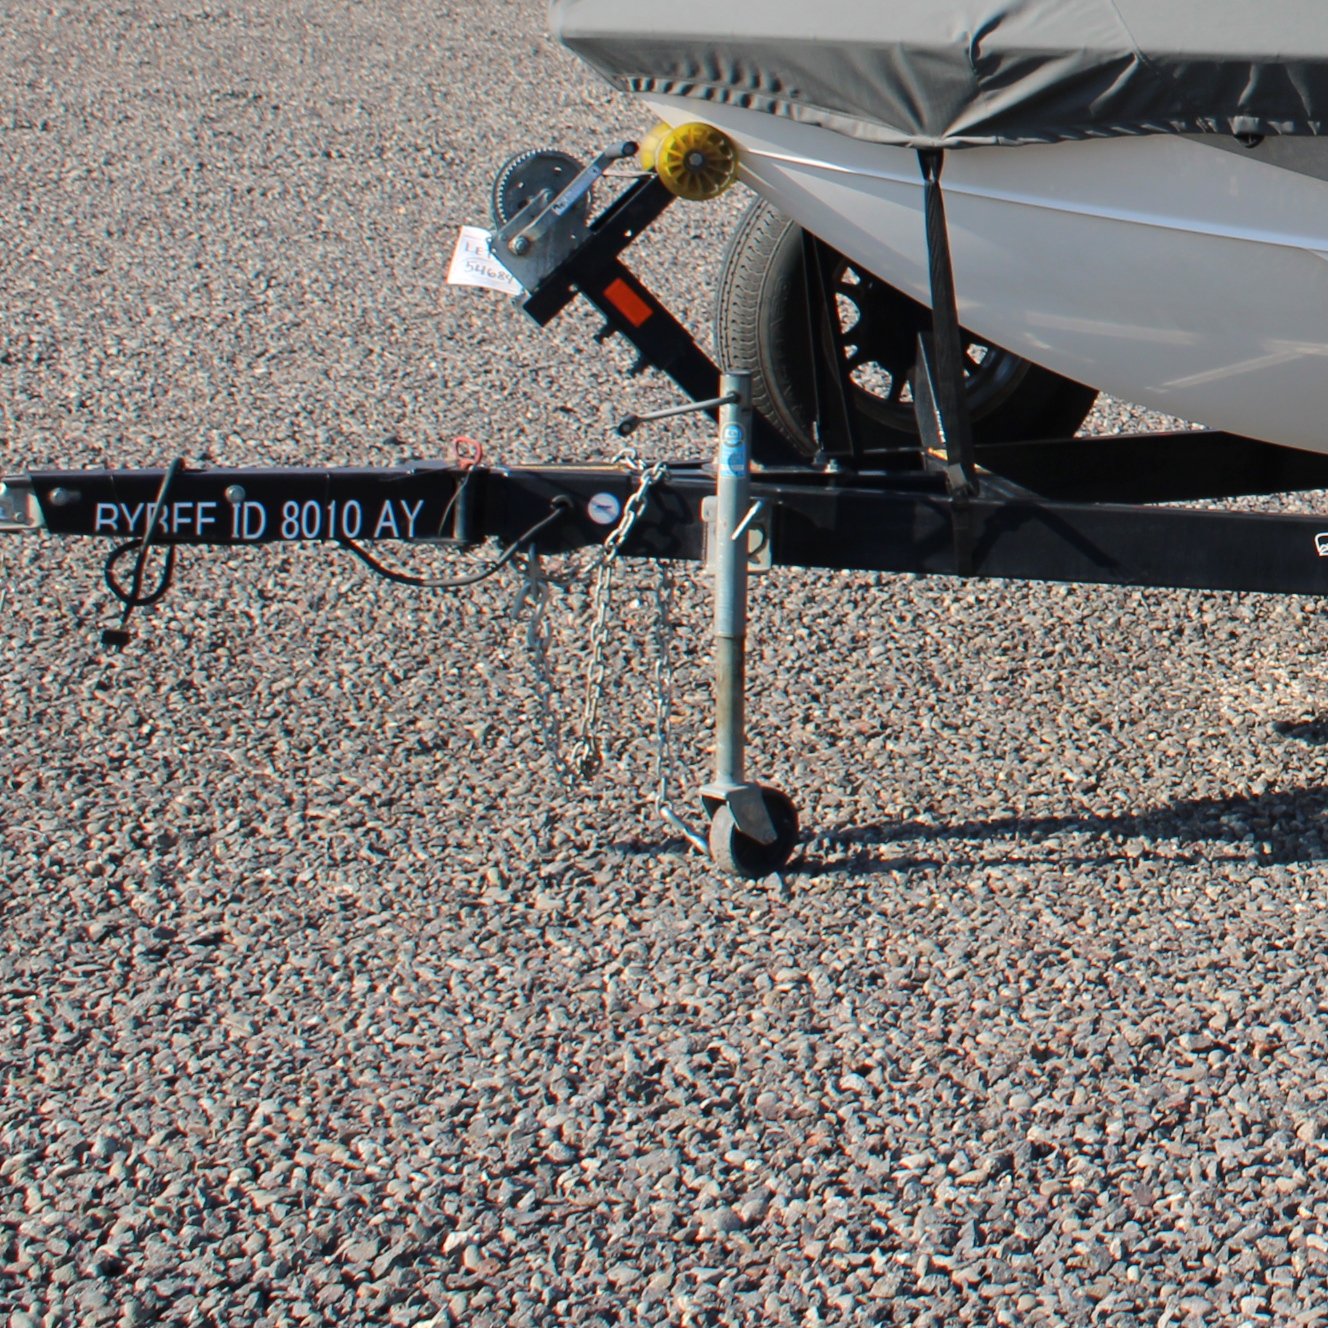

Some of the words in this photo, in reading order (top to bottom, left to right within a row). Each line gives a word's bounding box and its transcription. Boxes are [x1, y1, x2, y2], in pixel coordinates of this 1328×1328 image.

[231, 501, 267, 539] ID
[280, 500, 362, 539] 8010
[373, 500, 424, 538] AY
